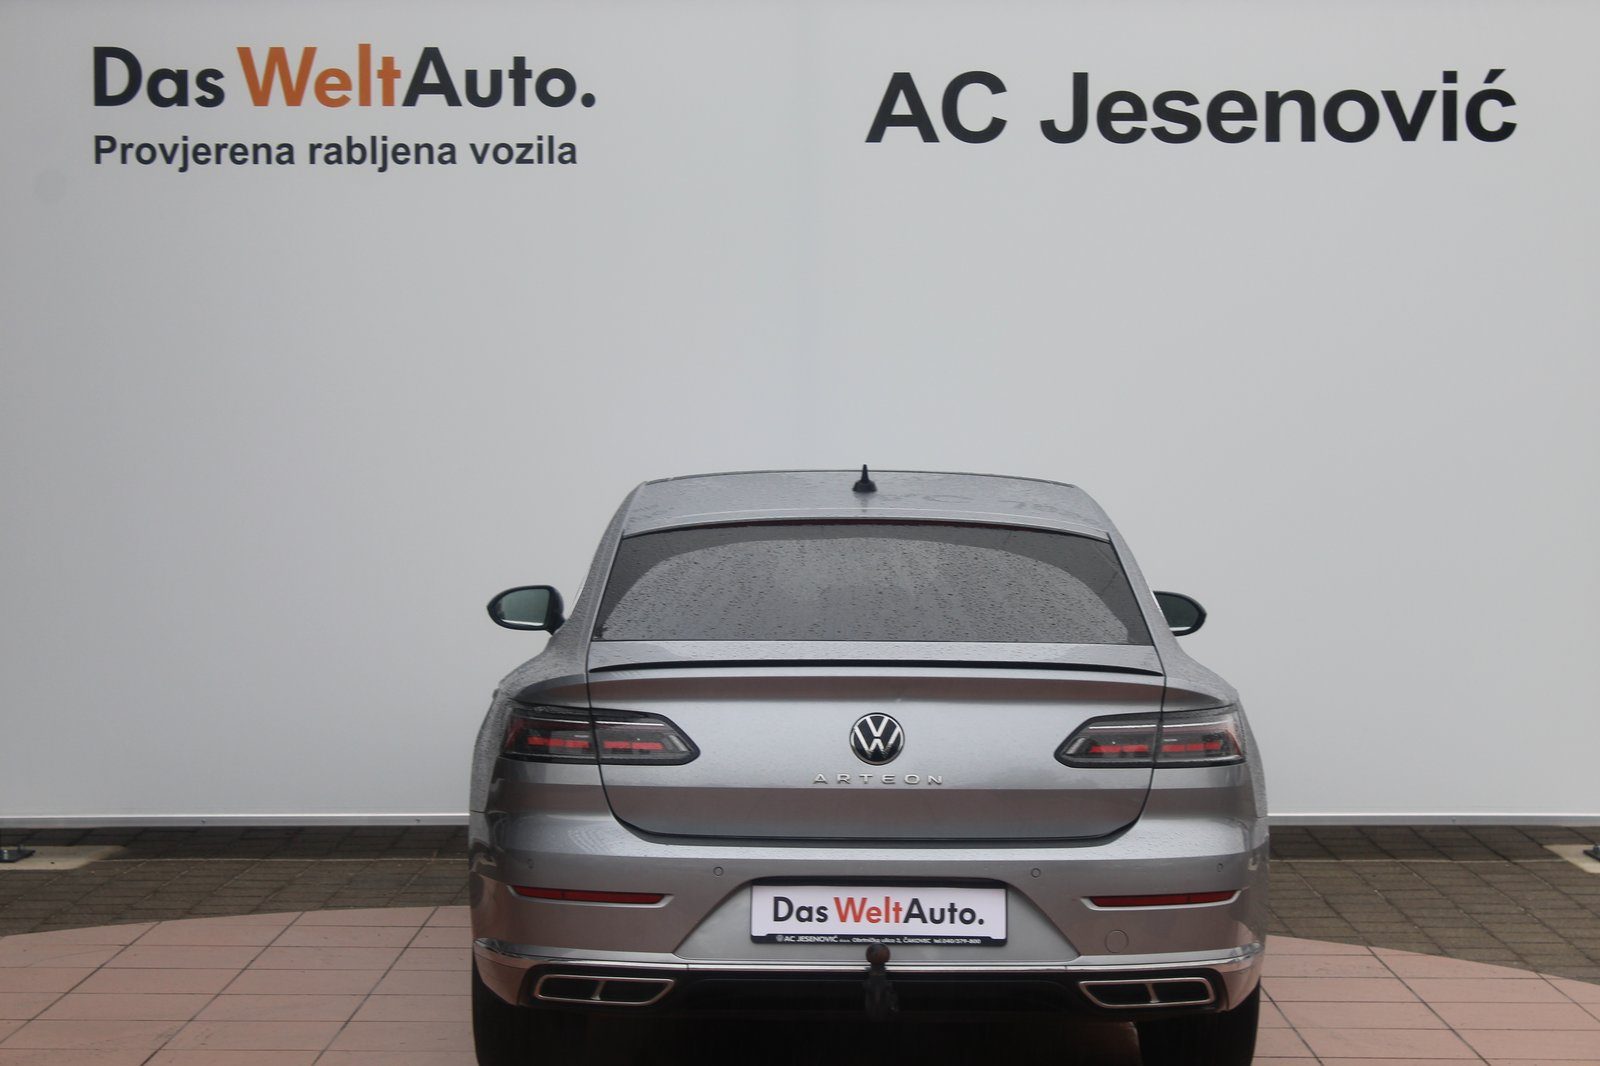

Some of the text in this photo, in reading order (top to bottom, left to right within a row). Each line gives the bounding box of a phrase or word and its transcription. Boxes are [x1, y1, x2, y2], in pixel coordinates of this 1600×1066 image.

[93, 44, 596, 109] Das WeltAuto.
[865, 69, 1518, 145] AC Jesenović
[93, 135, 578, 173] Provjerena rabljena vozila
[813, 773, 944, 786] ARTEON
[773, 896, 985, 926] Das WeltAuto.
[784, 935, 796, 943] AC
[796, 934, 839, 943] JESENOVIĆ
